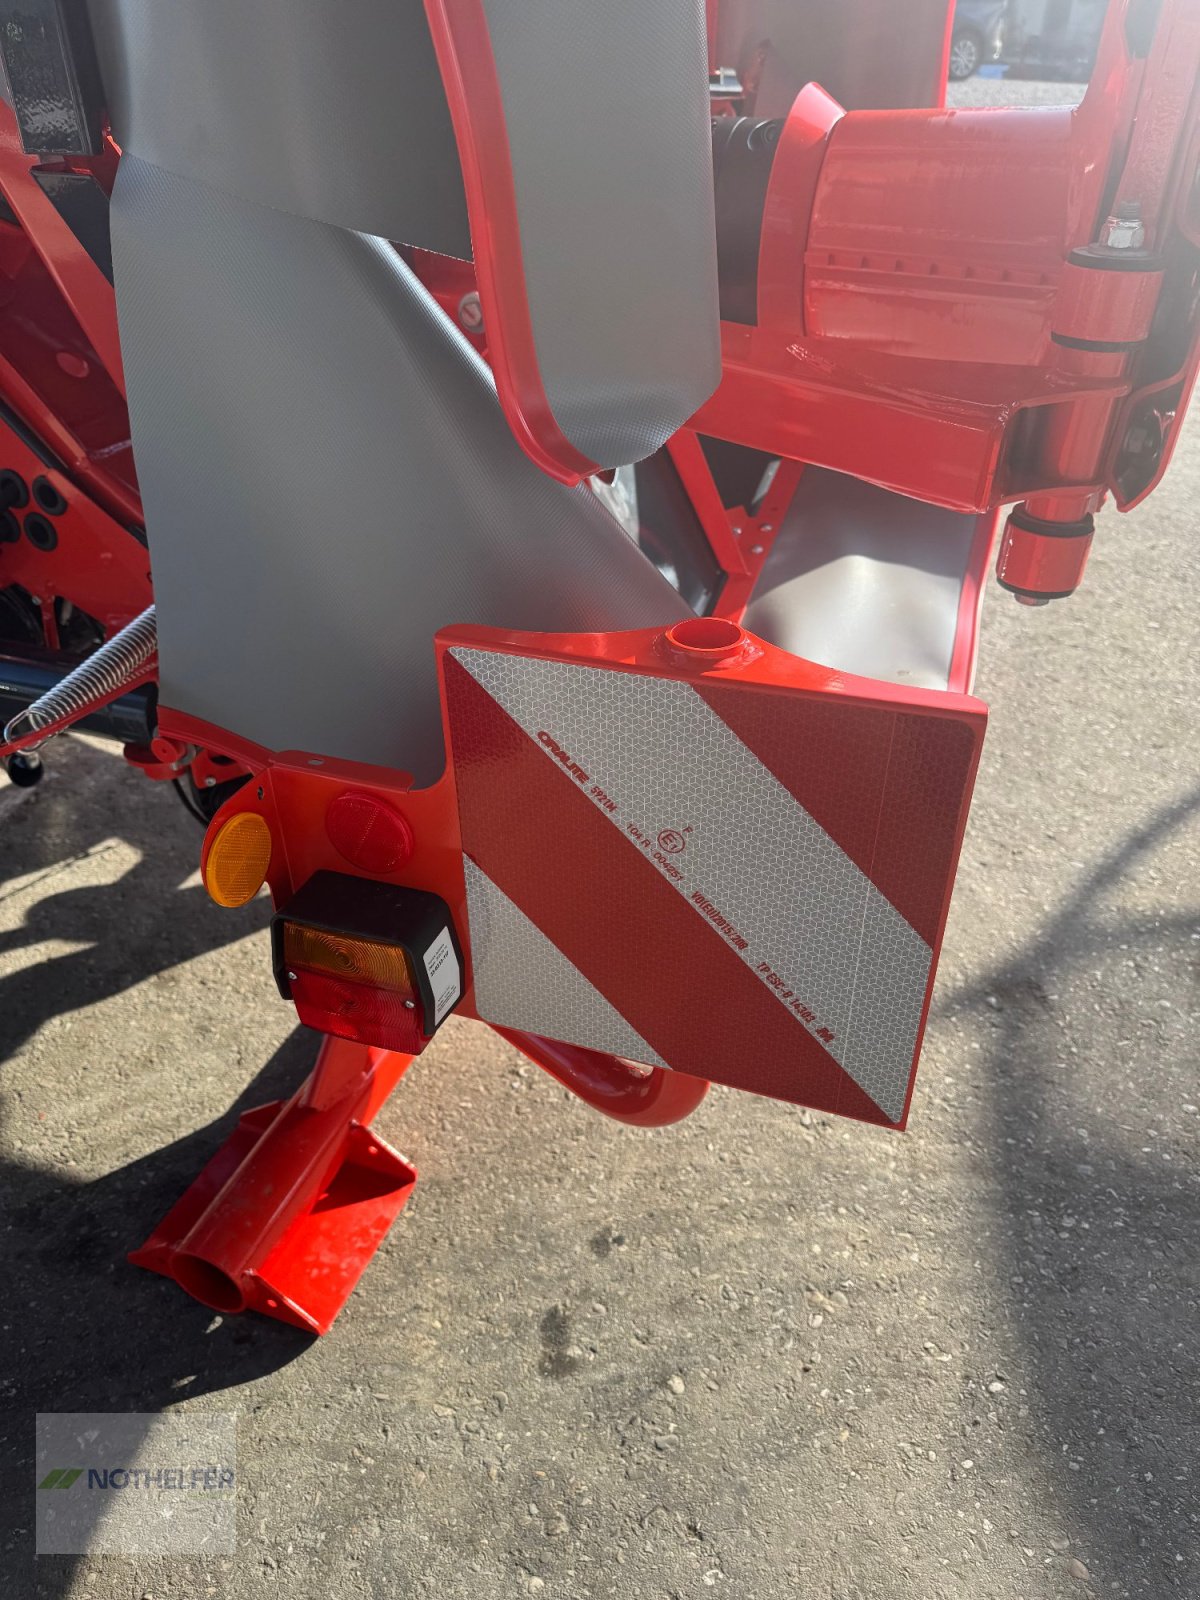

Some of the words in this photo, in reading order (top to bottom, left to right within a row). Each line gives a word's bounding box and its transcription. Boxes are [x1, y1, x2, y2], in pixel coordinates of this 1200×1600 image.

[537, 730, 590, 784] ORALITE
[590, 785, 617, 812] 5921M
[627, 823, 643, 839] 104
[653, 852, 684, 881] 004251
